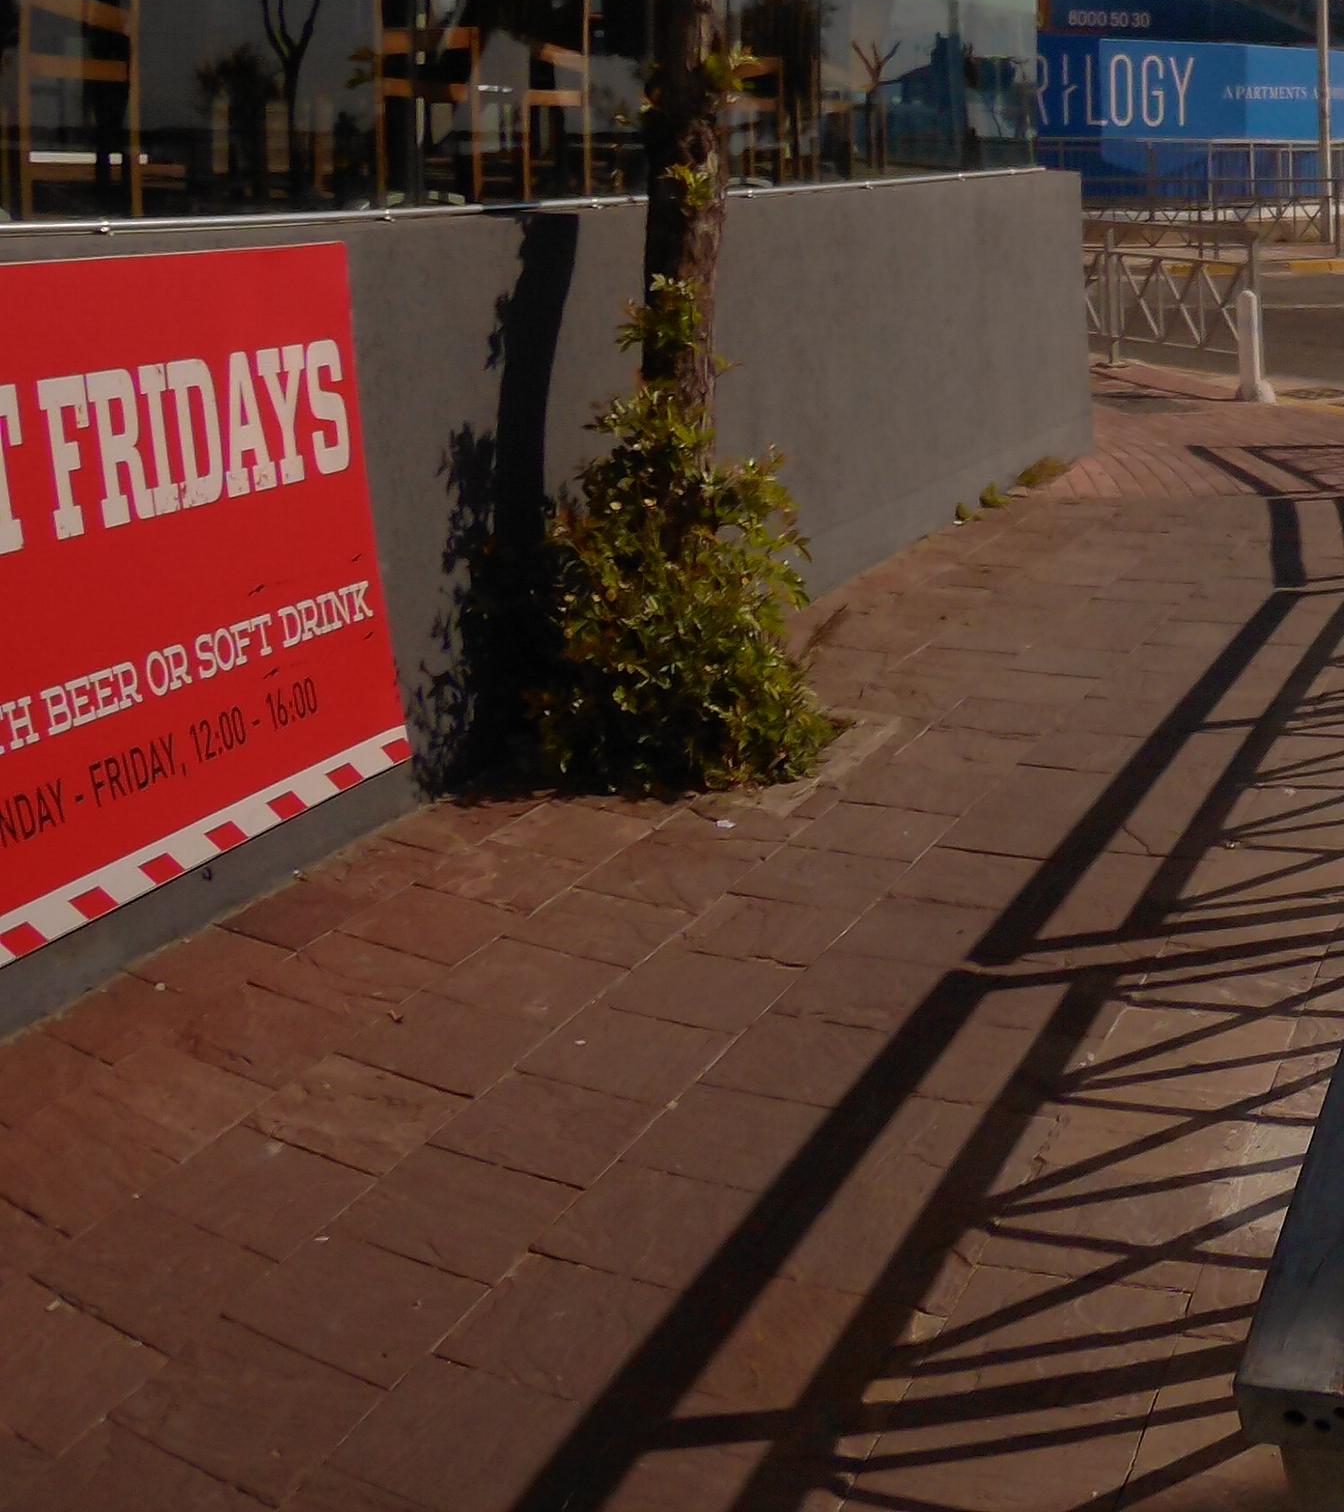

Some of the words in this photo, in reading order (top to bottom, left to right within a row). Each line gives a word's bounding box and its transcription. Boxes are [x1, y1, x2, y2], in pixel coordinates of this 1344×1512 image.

[1068, 9, 1107, 28] 8000
[1110, 11, 1128, 28] 50
[1132, 12, 1151, 29] 30
[38, 338, 351, 540] FRIDAYS
[40, 661, 143, 736] BEER
[145, 643, 193, 697] OR
[194, 613, 275, 680] SOFT
[279, 580, 374, 648] DRINK
[88, 733, 188, 808] FRIDAY,
[188, 705, 248, 764] 12:00
[264, 676, 319, 729] 16:00
